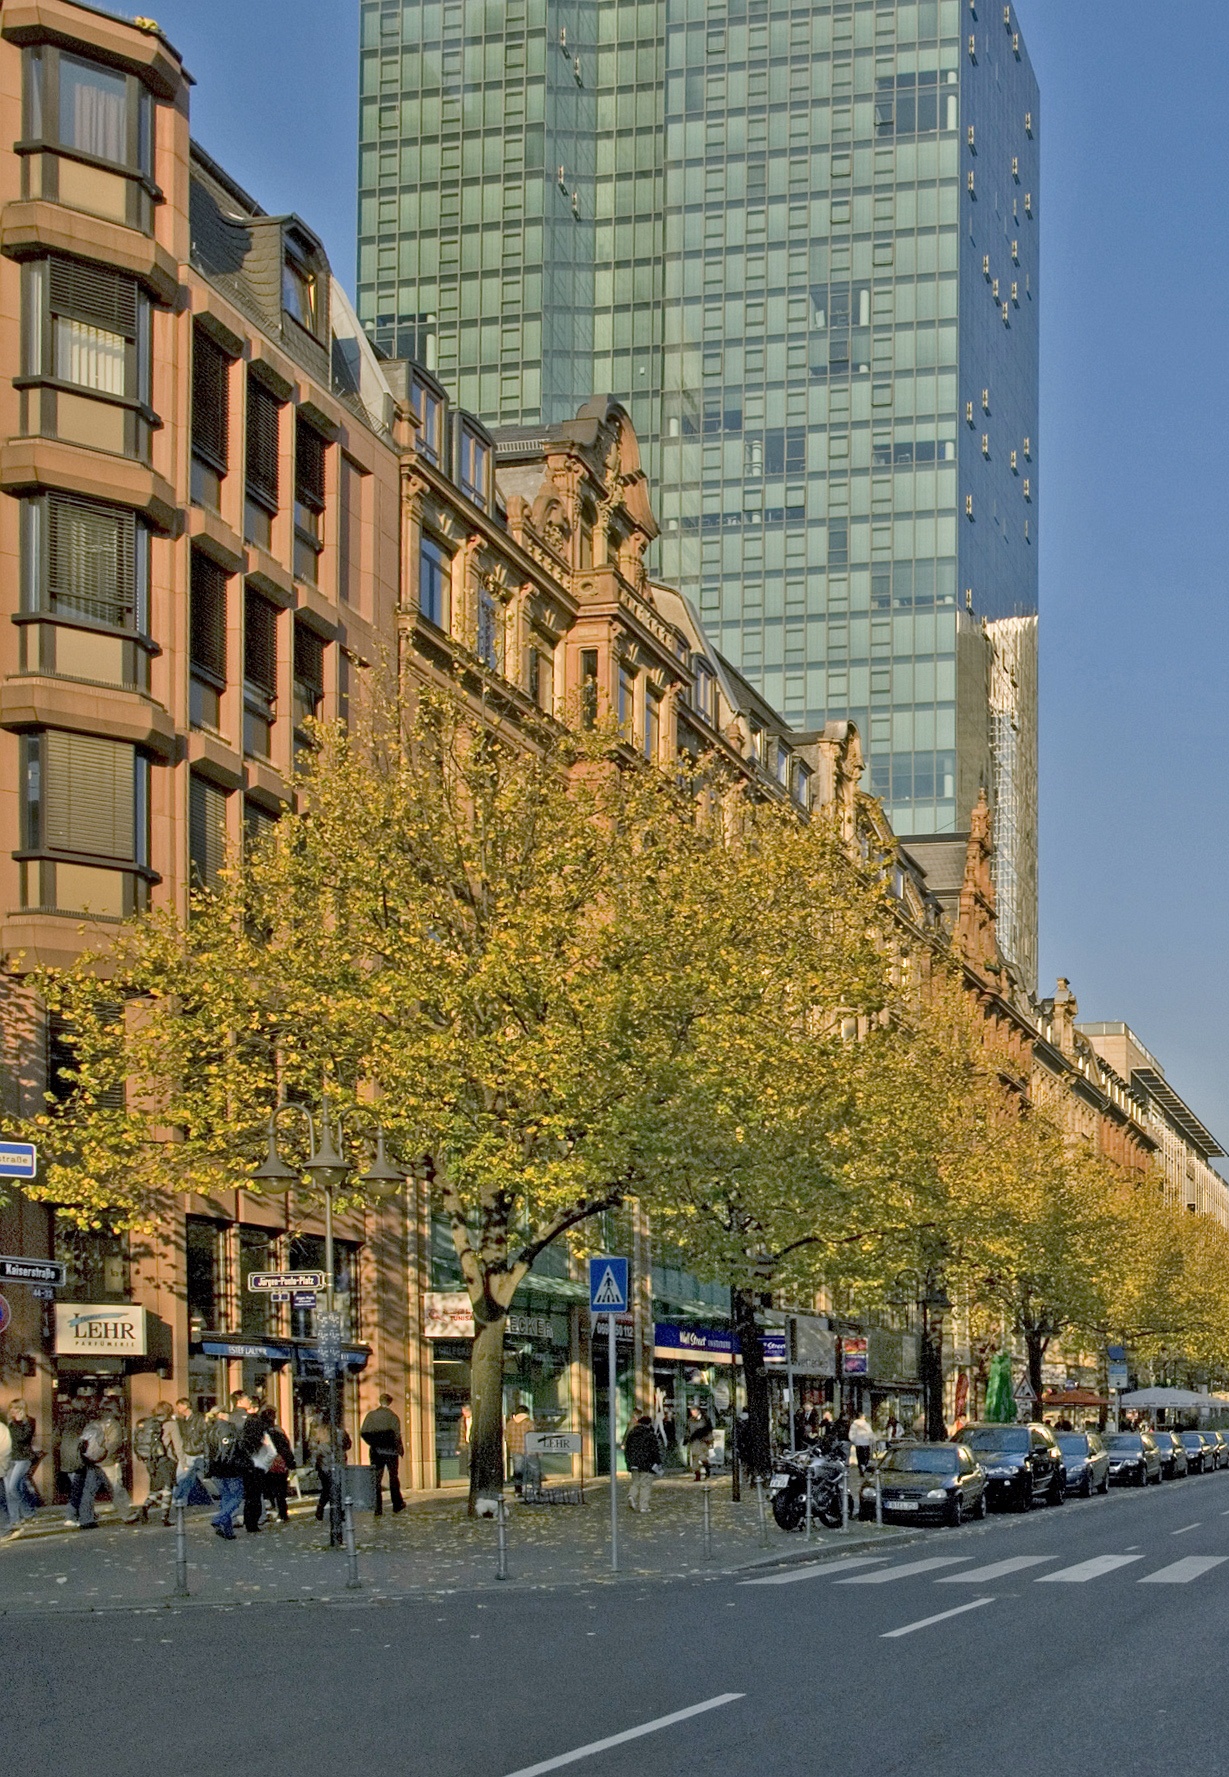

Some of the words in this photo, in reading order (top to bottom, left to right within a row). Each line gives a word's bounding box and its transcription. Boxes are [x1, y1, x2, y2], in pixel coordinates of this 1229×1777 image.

[5, 1263, 56, 1279] Kaiserstraße
[74, 1313, 136, 1339] LEHR
[543, 1435, 570, 1449] LEHR
